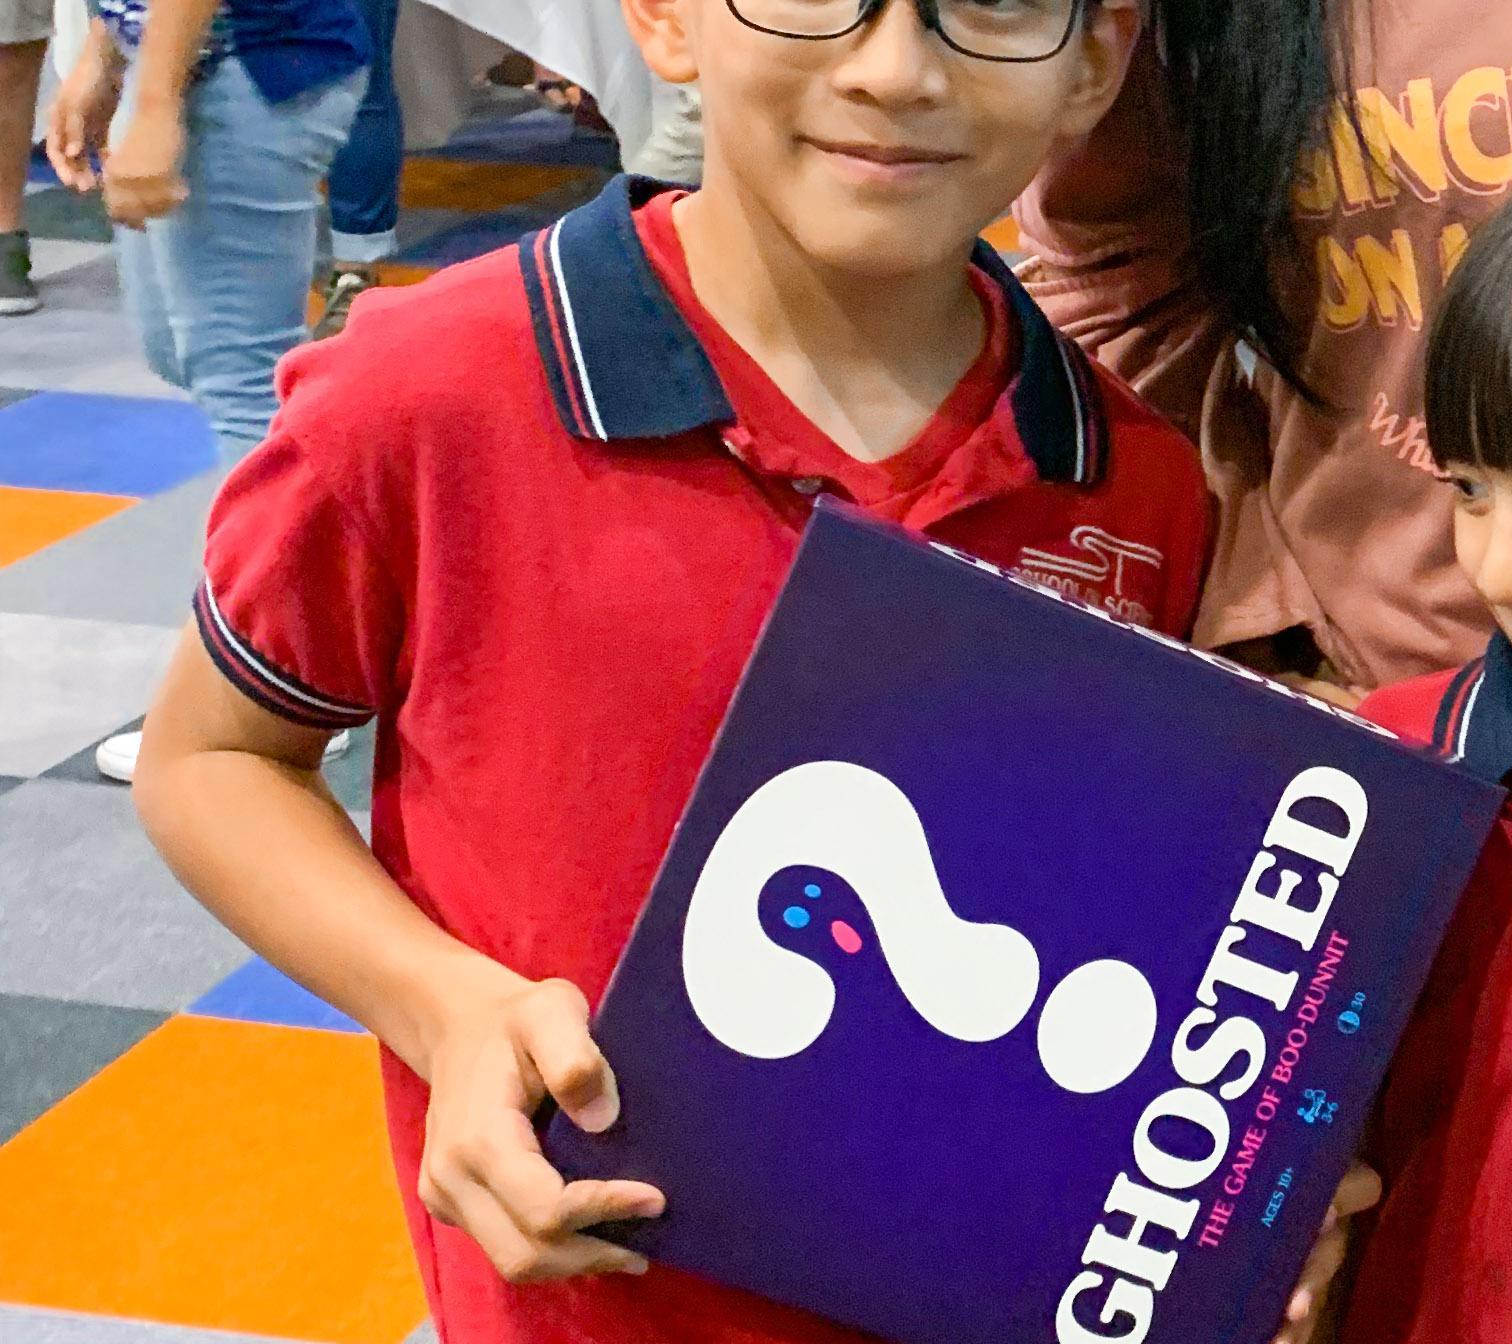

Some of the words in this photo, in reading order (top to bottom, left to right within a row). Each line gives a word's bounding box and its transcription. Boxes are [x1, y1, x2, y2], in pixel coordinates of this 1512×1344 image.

[1351, 991, 1367, 1011] 30
[1198, 1199, 1235, 1248] THE
[1223, 1125, 1267, 1196] GAME
[1256, 1085, 1281, 1122] OF
[1271, 930, 1349, 1086] BOO-DUNNIT
[1260, 1191, 1286, 1228] AGES
[1277, 1167, 1295, 1190] 10+
